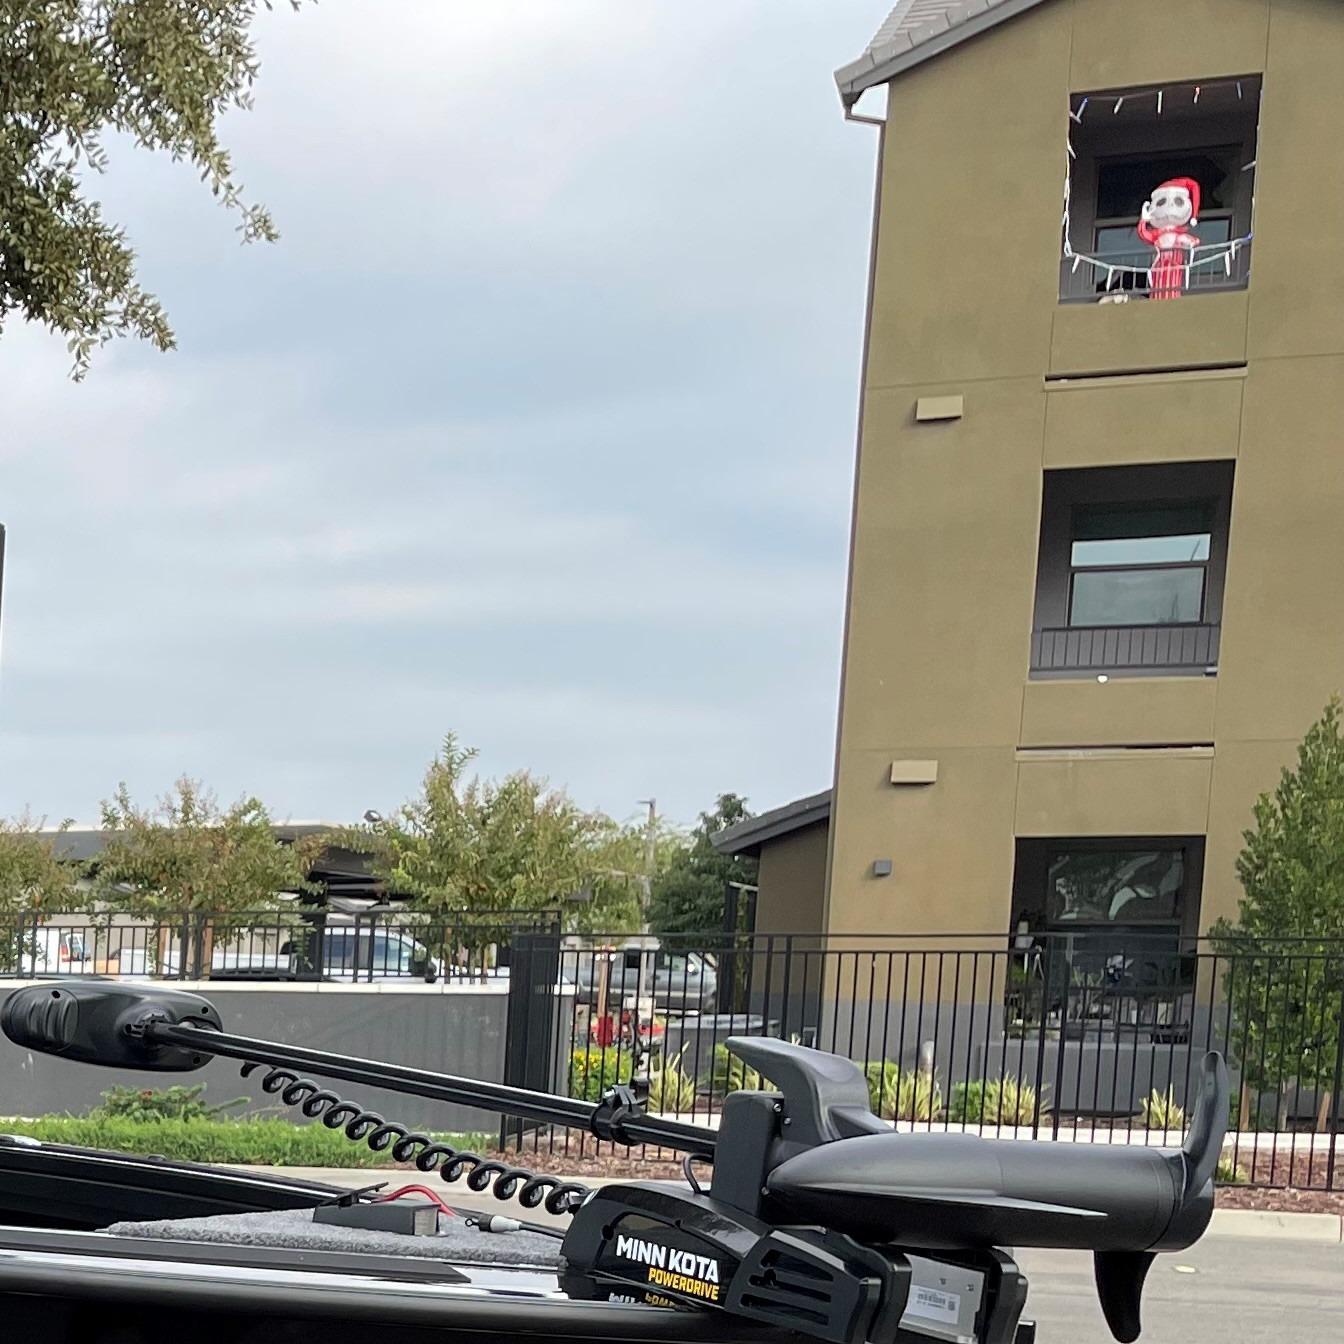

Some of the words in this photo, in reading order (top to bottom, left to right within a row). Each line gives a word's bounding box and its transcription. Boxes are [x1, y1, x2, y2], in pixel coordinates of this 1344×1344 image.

[616, 1234, 667, 1269] MINN
[668, 1248, 719, 1284] KOTA
[648, 1267, 720, 1301] POWERDRIVE
